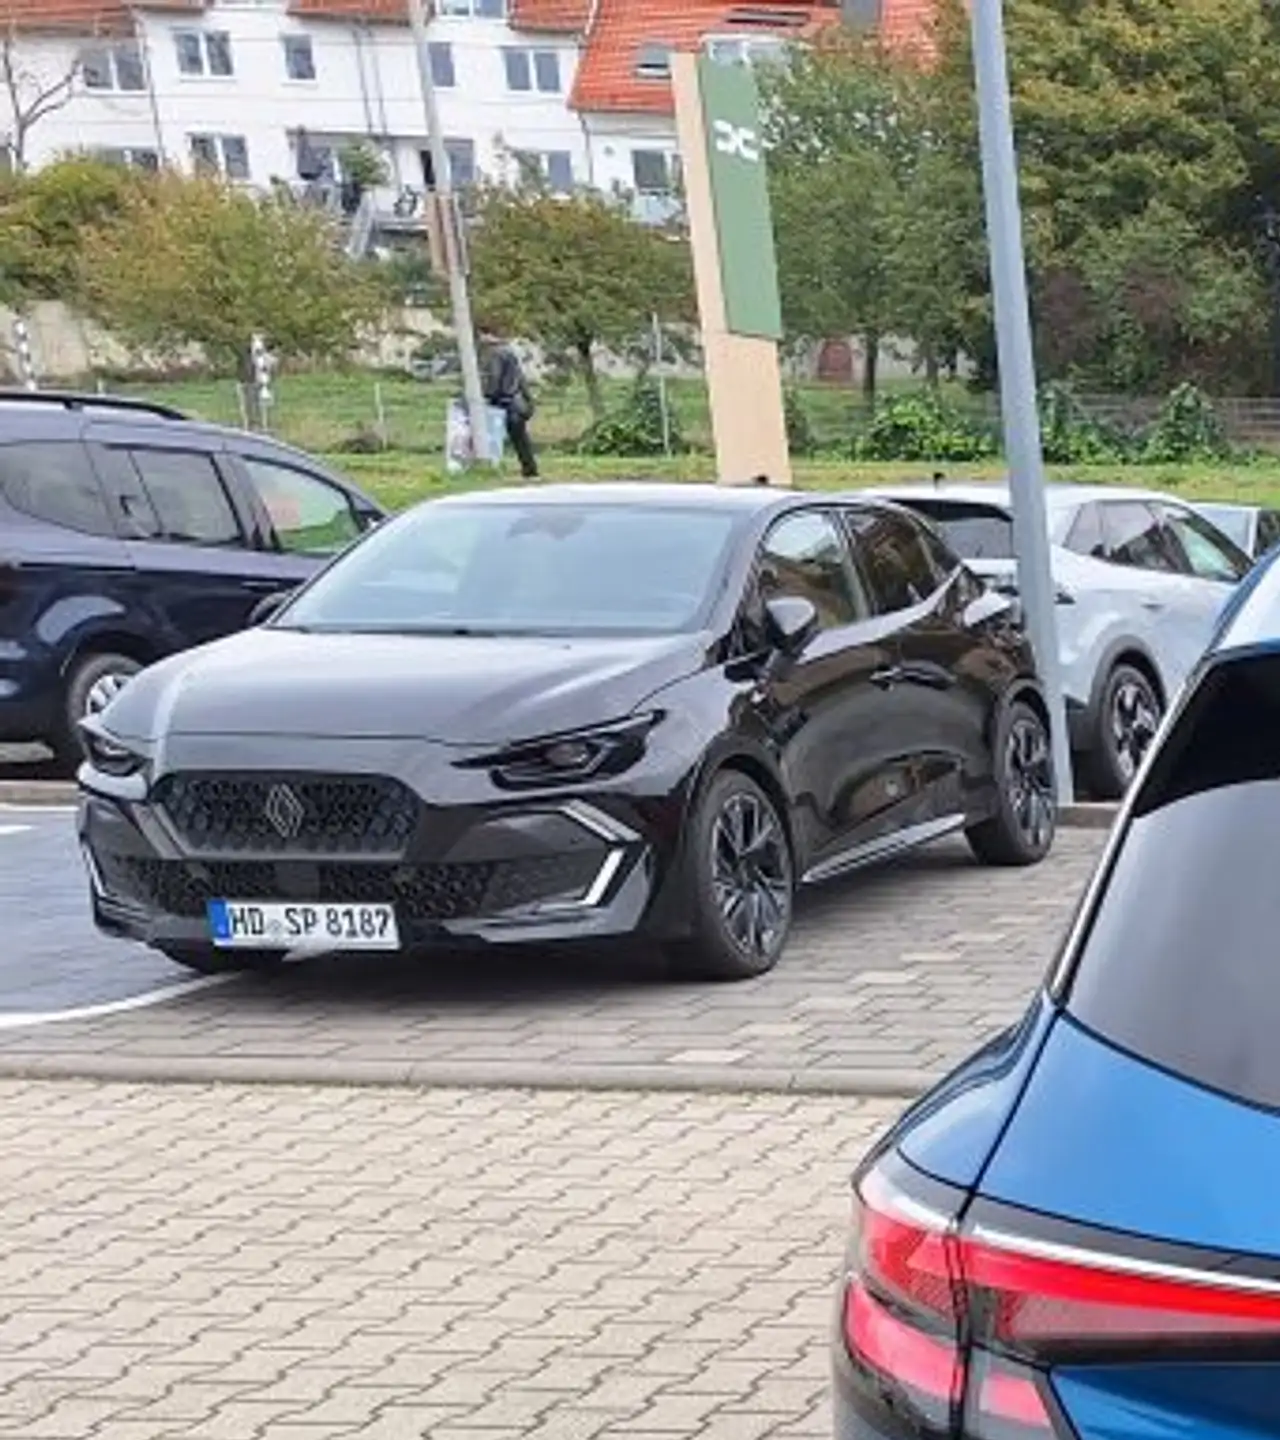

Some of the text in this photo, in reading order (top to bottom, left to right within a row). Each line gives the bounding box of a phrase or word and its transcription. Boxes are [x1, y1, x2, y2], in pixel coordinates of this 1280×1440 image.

[229, 907, 390, 938] HD SP 8187
